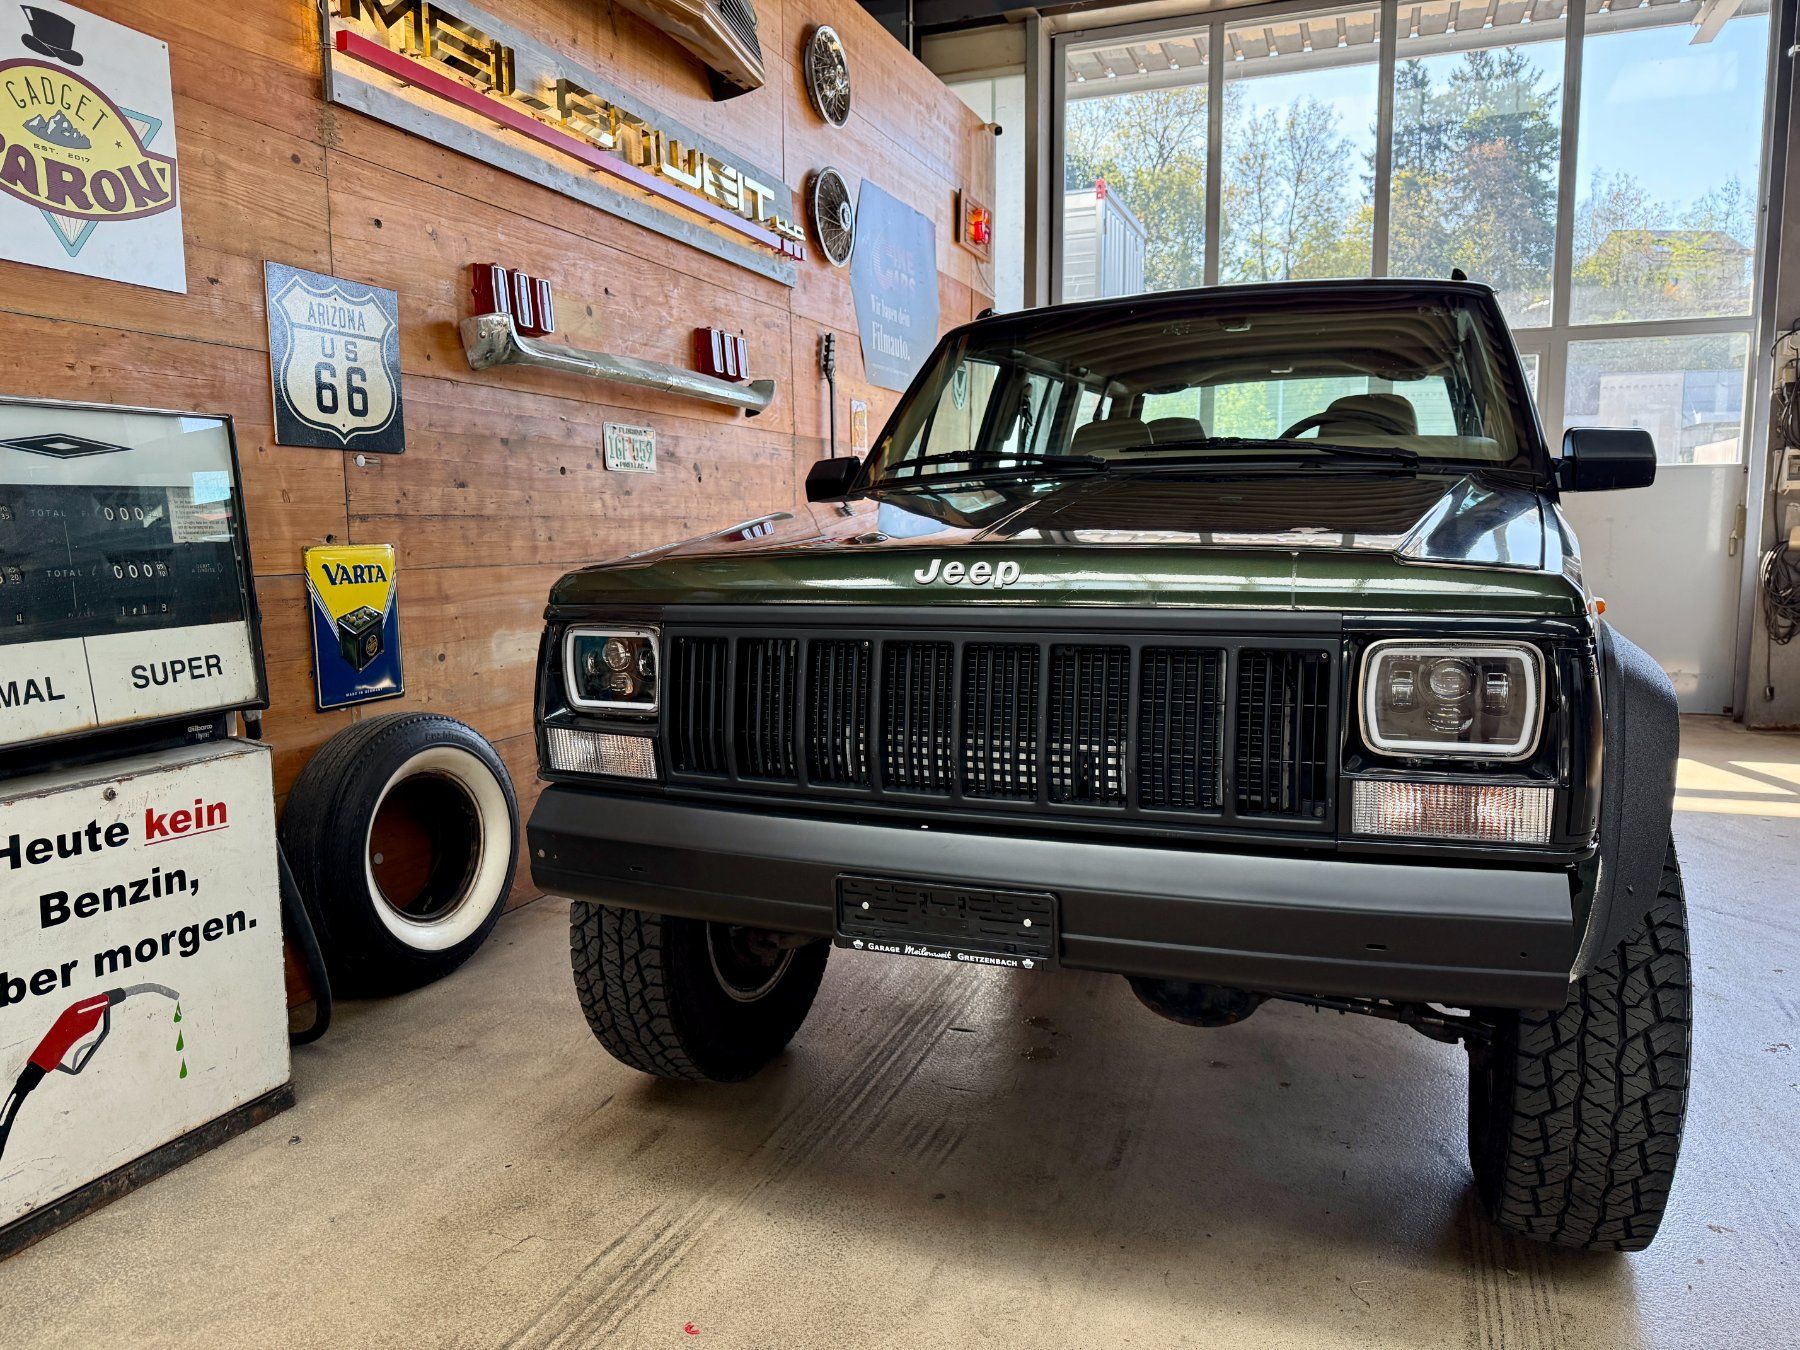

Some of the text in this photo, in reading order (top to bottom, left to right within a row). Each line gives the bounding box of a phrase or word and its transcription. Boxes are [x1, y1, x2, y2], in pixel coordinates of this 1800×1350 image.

[5, 76, 109, 131] GADGET
[33, 142, 92, 163] EST. 2017
[0, 134, 170, 212] ARON
[307, 301, 367, 333] ARIZONA
[871, 320, 911, 361] Filmauto.
[314, 361, 369, 418] 66
[30, 508, 67, 517] TOTAL
[46, 569, 82, 578] TOTAL
[321, 563, 388, 586] VARTA
[914, 559, 1020, 589] Jeep
[131, 654, 223, 689] SUPER
[145, 798, 228, 841] kein
[39, 866, 199, 929] Benzin,
[94, 909, 257, 978] morgen.
[868, 942, 1018, 968] GARAGE Meilenweit GRETZENBACH
